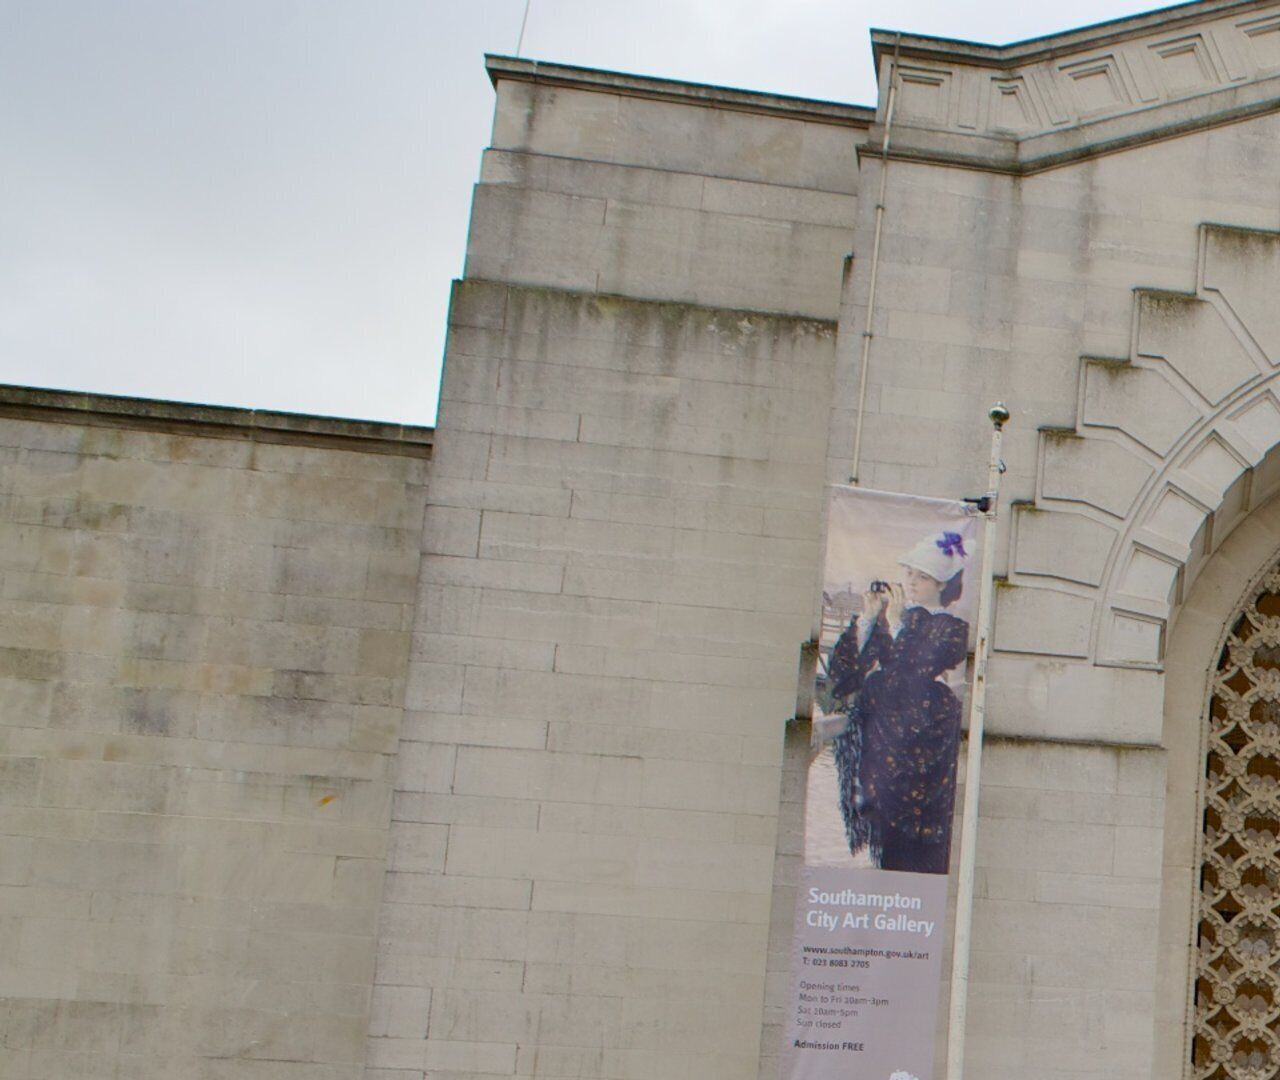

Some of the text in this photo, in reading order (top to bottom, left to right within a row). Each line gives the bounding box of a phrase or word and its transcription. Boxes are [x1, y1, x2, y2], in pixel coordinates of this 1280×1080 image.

[808, 887, 921, 911] Southampton
[806, 910, 935, 937] City Art Gallery
[802, 945, 930, 961] www.southampton.gov.uk/art
[800, 981, 861, 993] Opening times
[794, 1039, 865, 1052] Admission FREE
